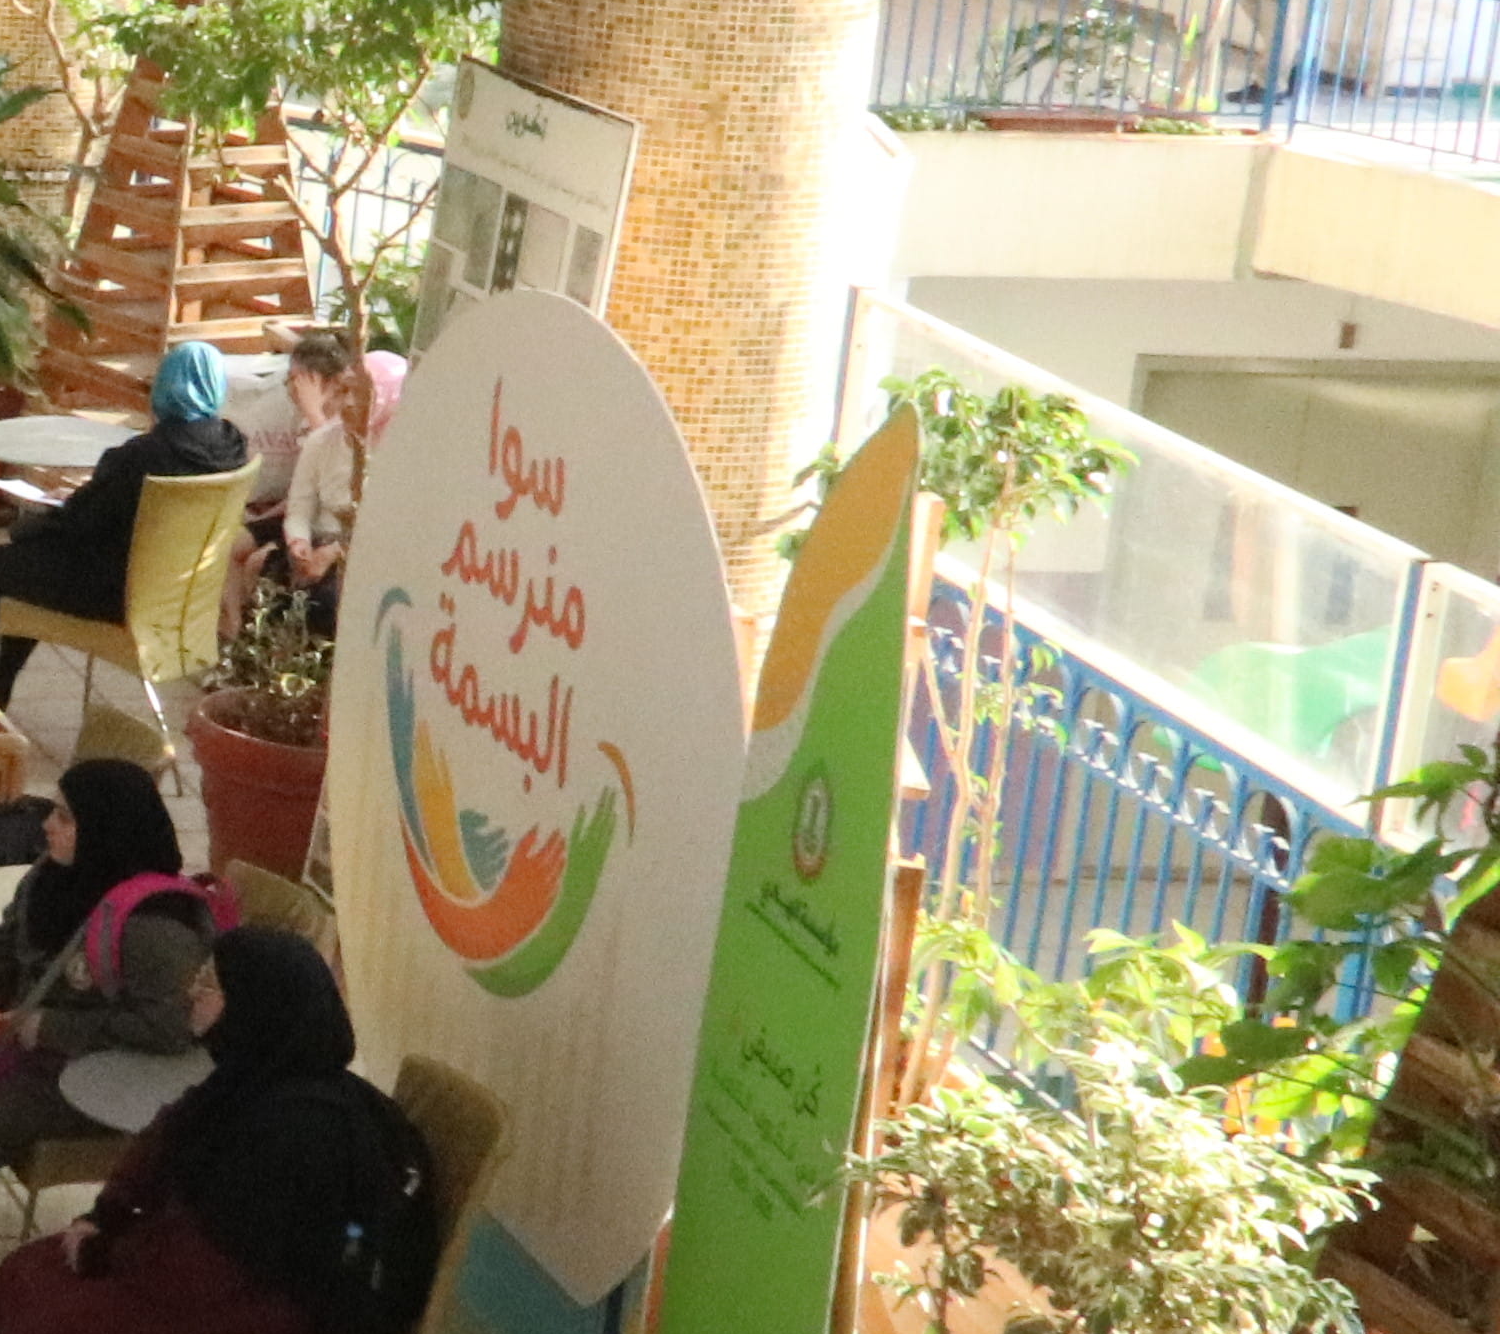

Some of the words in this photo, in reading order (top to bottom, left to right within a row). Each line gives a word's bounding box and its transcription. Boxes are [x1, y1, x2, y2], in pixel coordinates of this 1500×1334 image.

[488, 376, 566, 520] سوا
[441, 520, 586, 654] منرسم
[430, 592, 574, 794] البسمة
